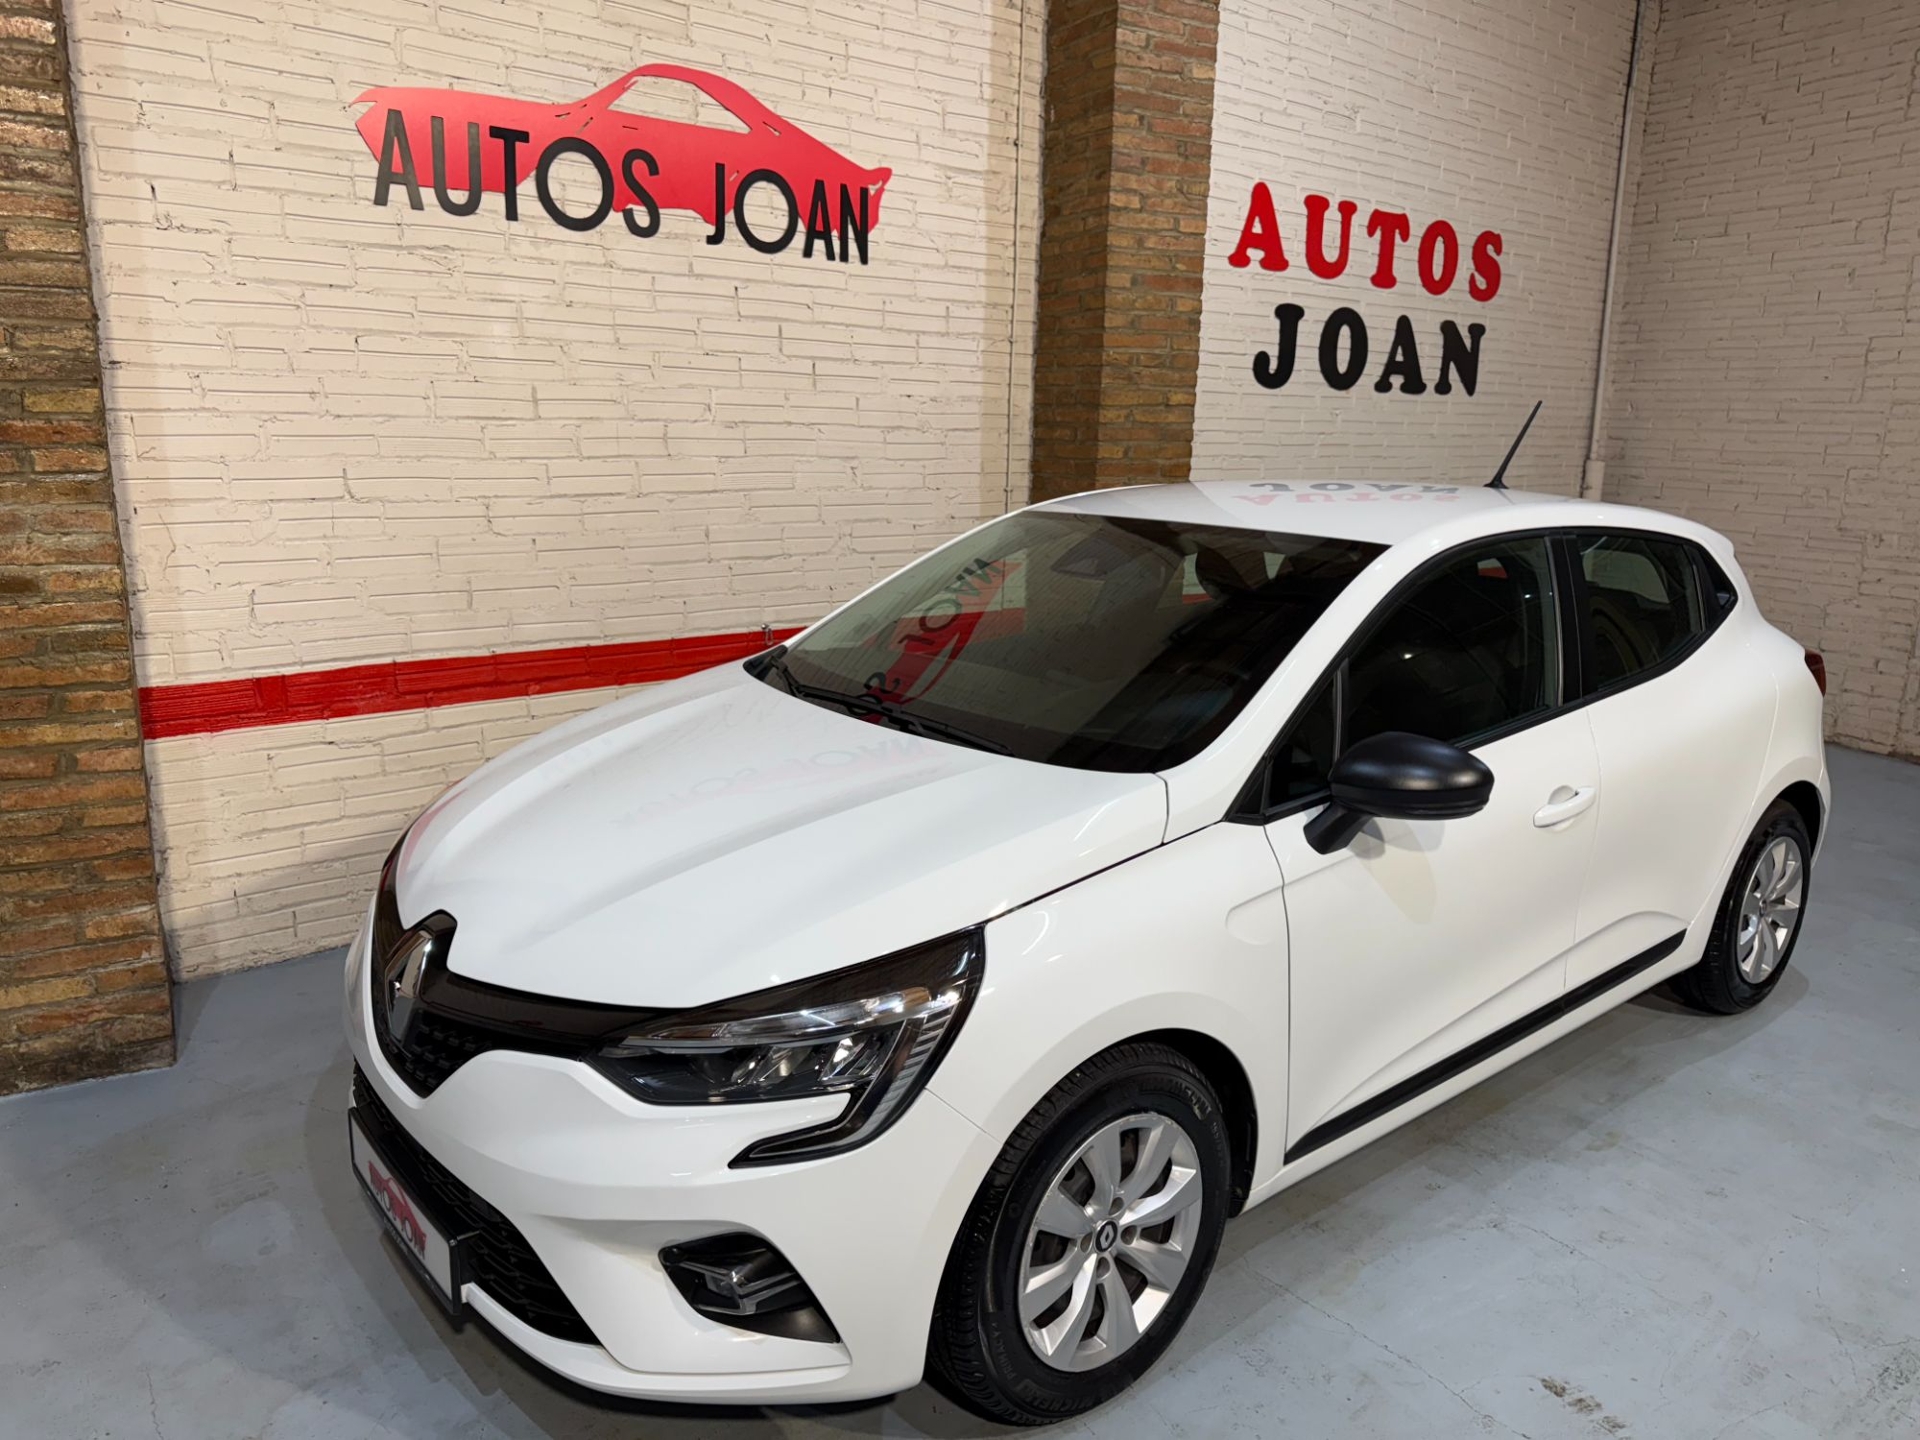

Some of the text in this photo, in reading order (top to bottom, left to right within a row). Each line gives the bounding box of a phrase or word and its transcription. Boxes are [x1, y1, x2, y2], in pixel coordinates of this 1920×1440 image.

[373, 108, 869, 265] AUTOS JOAN
[1228, 181, 1503, 302] AUTOS
[1252, 302, 1486, 397] JOAN
